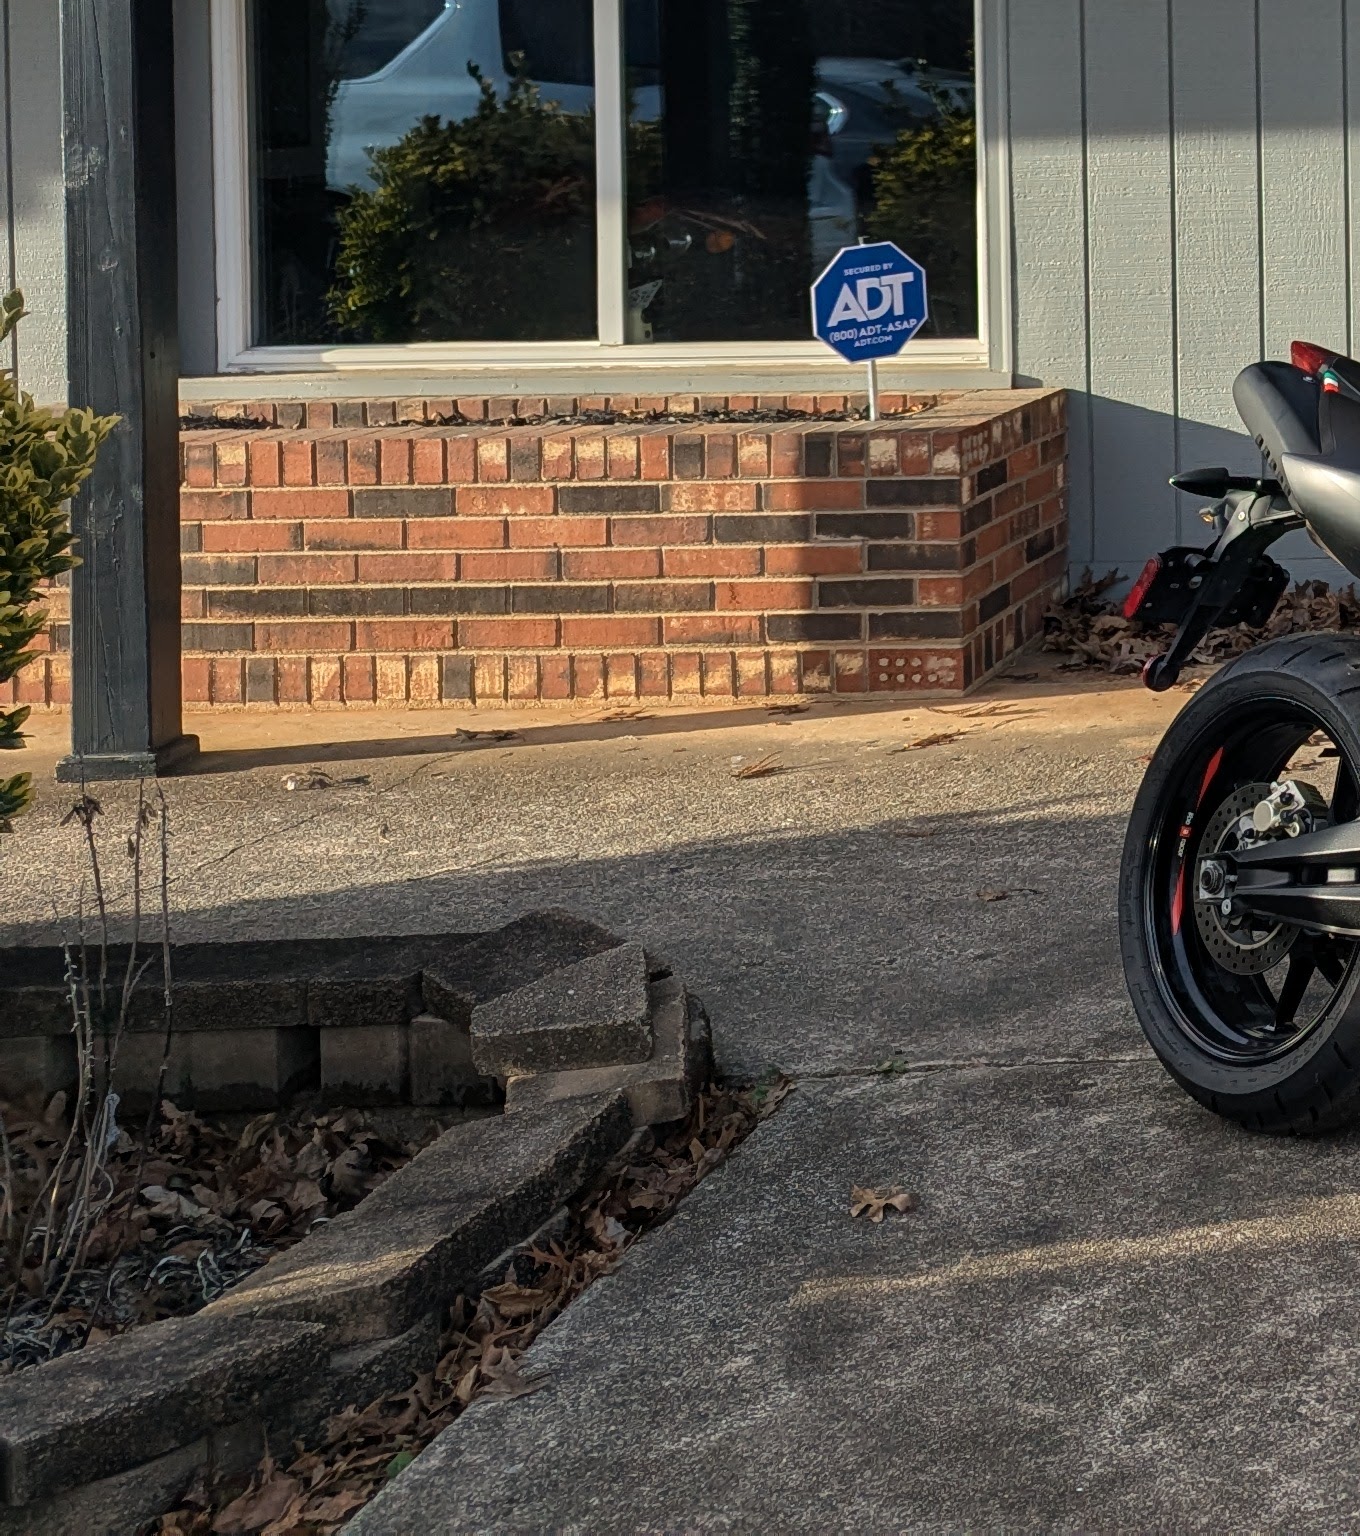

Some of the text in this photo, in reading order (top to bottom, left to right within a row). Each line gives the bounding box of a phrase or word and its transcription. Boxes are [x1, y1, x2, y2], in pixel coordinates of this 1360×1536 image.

[843, 263, 882, 276] SECURED
[826, 272, 914, 328] ADT
[829, 318, 918, 344] (800) ADT-ASAP
[853, 335, 893, 348] ADT.COM
